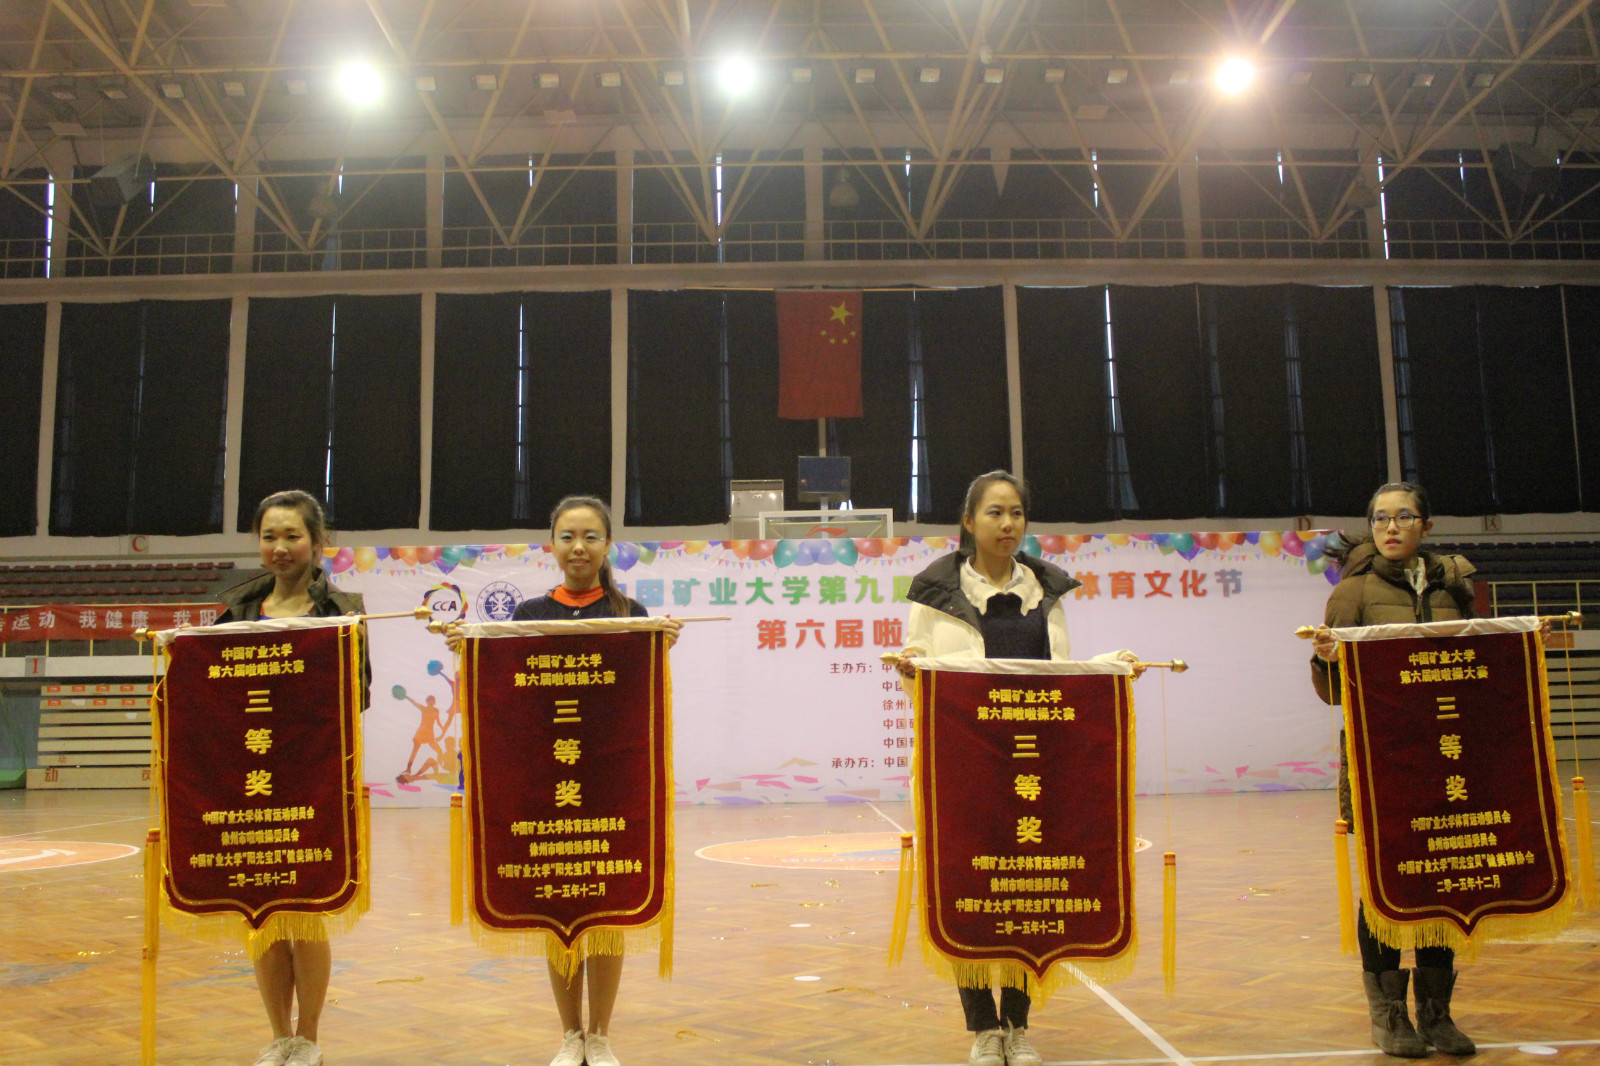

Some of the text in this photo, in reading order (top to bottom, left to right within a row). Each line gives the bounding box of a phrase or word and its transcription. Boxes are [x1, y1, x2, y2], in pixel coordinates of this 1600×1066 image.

[132, 536, 146, 552] C
[1075, 569, 1242, 600] 体育文化节
[432, 600, 457, 611] CCA
[0, 610, 56, 632] 运动
[79, 610, 149, 629] 我健康
[757, 619, 903, 650] 第六届啦
[222, 643, 293, 662] 中国矿业大学
[526, 653, 603, 669] 中国矿业大学
[1408, 649, 1476, 666] 中国矿业大学
[208, 659, 304, 679] 第六届啦啦操大赛
[1400, 665, 1489, 684] 第六届啦啦操大赛
[514, 670, 616, 687] 第六届啦啦操大赛
[988, 689, 1062, 703] 中国矿业大学
[977, 706, 1076, 721] 第六届啦啦操大赛
[45, 768, 59, 782] 动
[202, 806, 315, 825] 中国矿业大学体育运动委员会
[1411, 810, 1511, 832] 中国矿业大学体育运动委员会
[511, 817, 626, 836] 中国矿业大学体育运动委员会
[971, 855, 1086, 870] 中国矿业大学体育运动委员会
[228, 870, 297, 887] 二零一五年十二月
[1436, 874, 1501, 893] 二零一五年十二月
[535, 882, 606, 899] 二零一五年十二月
[995, 920, 1065, 935] 二零一五年十二月
